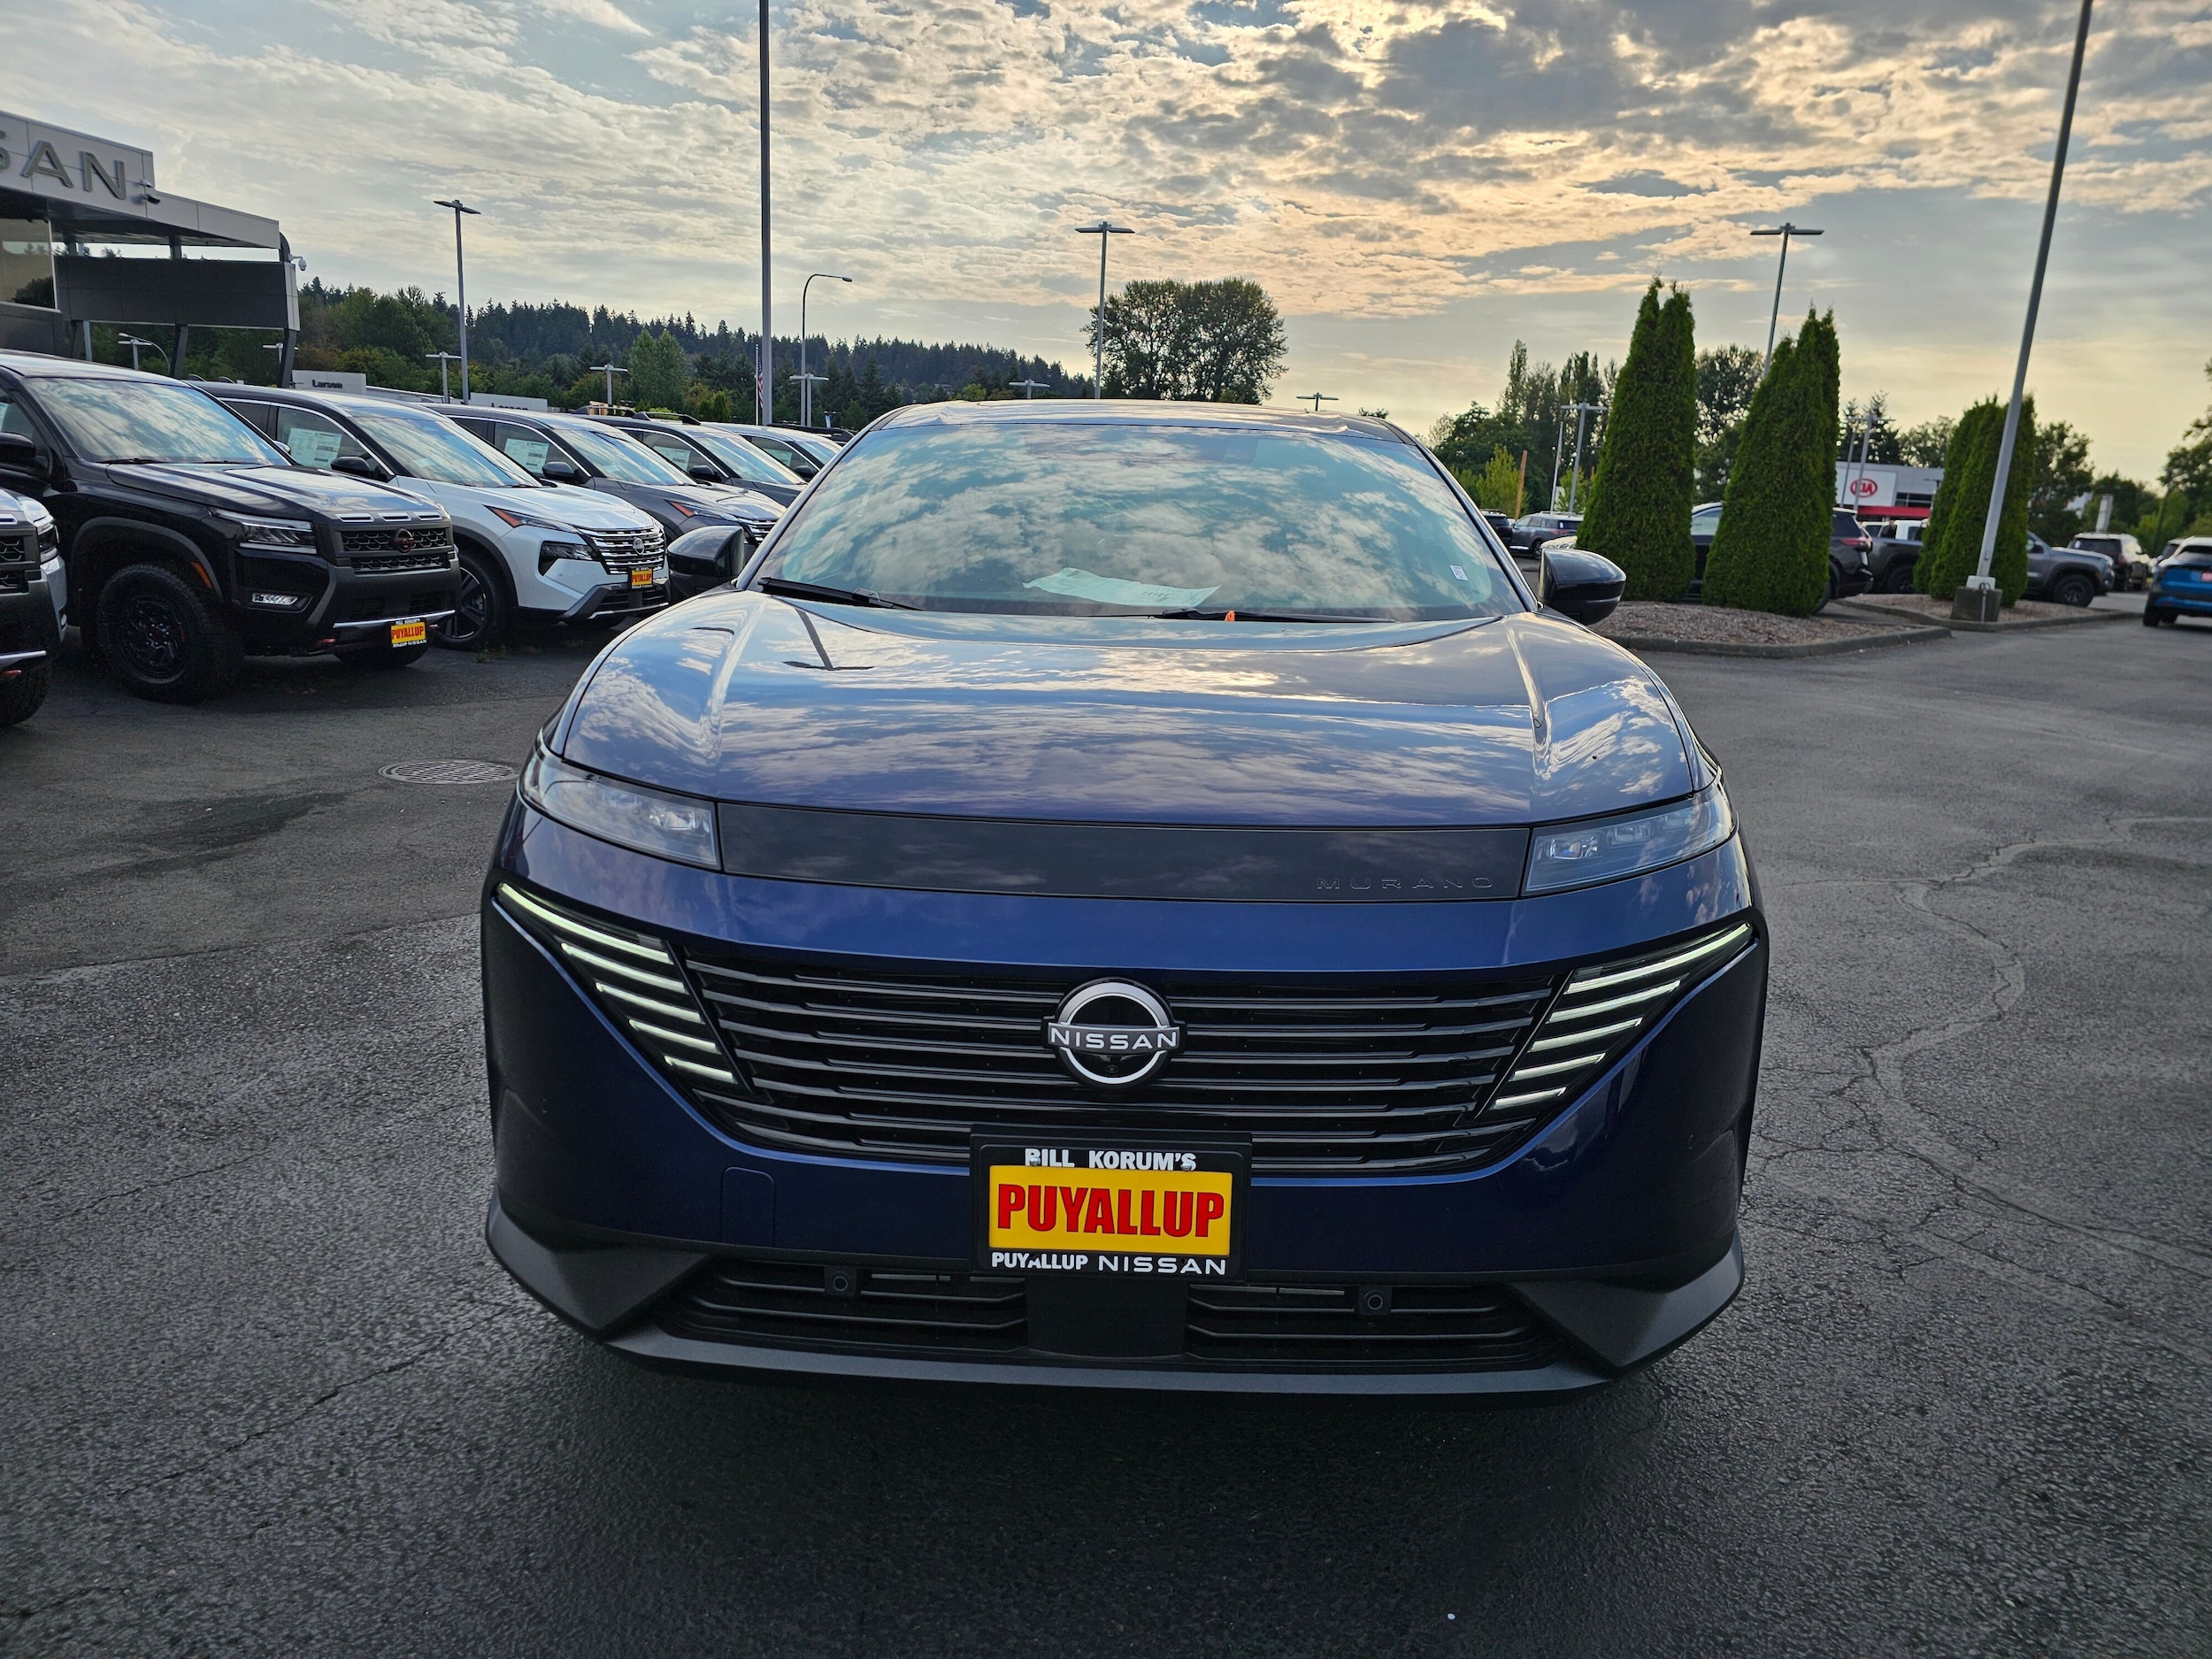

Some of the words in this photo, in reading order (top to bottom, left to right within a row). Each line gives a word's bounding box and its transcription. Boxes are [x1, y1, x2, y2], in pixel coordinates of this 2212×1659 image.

[311, 379, 342, 388] Larson
[392, 626, 424, 639] PUYALLUP
[1317, 877, 1493, 889] MURANO
[1050, 1027, 1177, 1050] NISSAN
[1025, 1148, 1075, 1167] BILL
[1088, 1150, 1197, 1171] KORUM'S
[998, 1184, 1225, 1238] PUYALLUP
[1098, 1256, 1226, 1276] NISSAN
